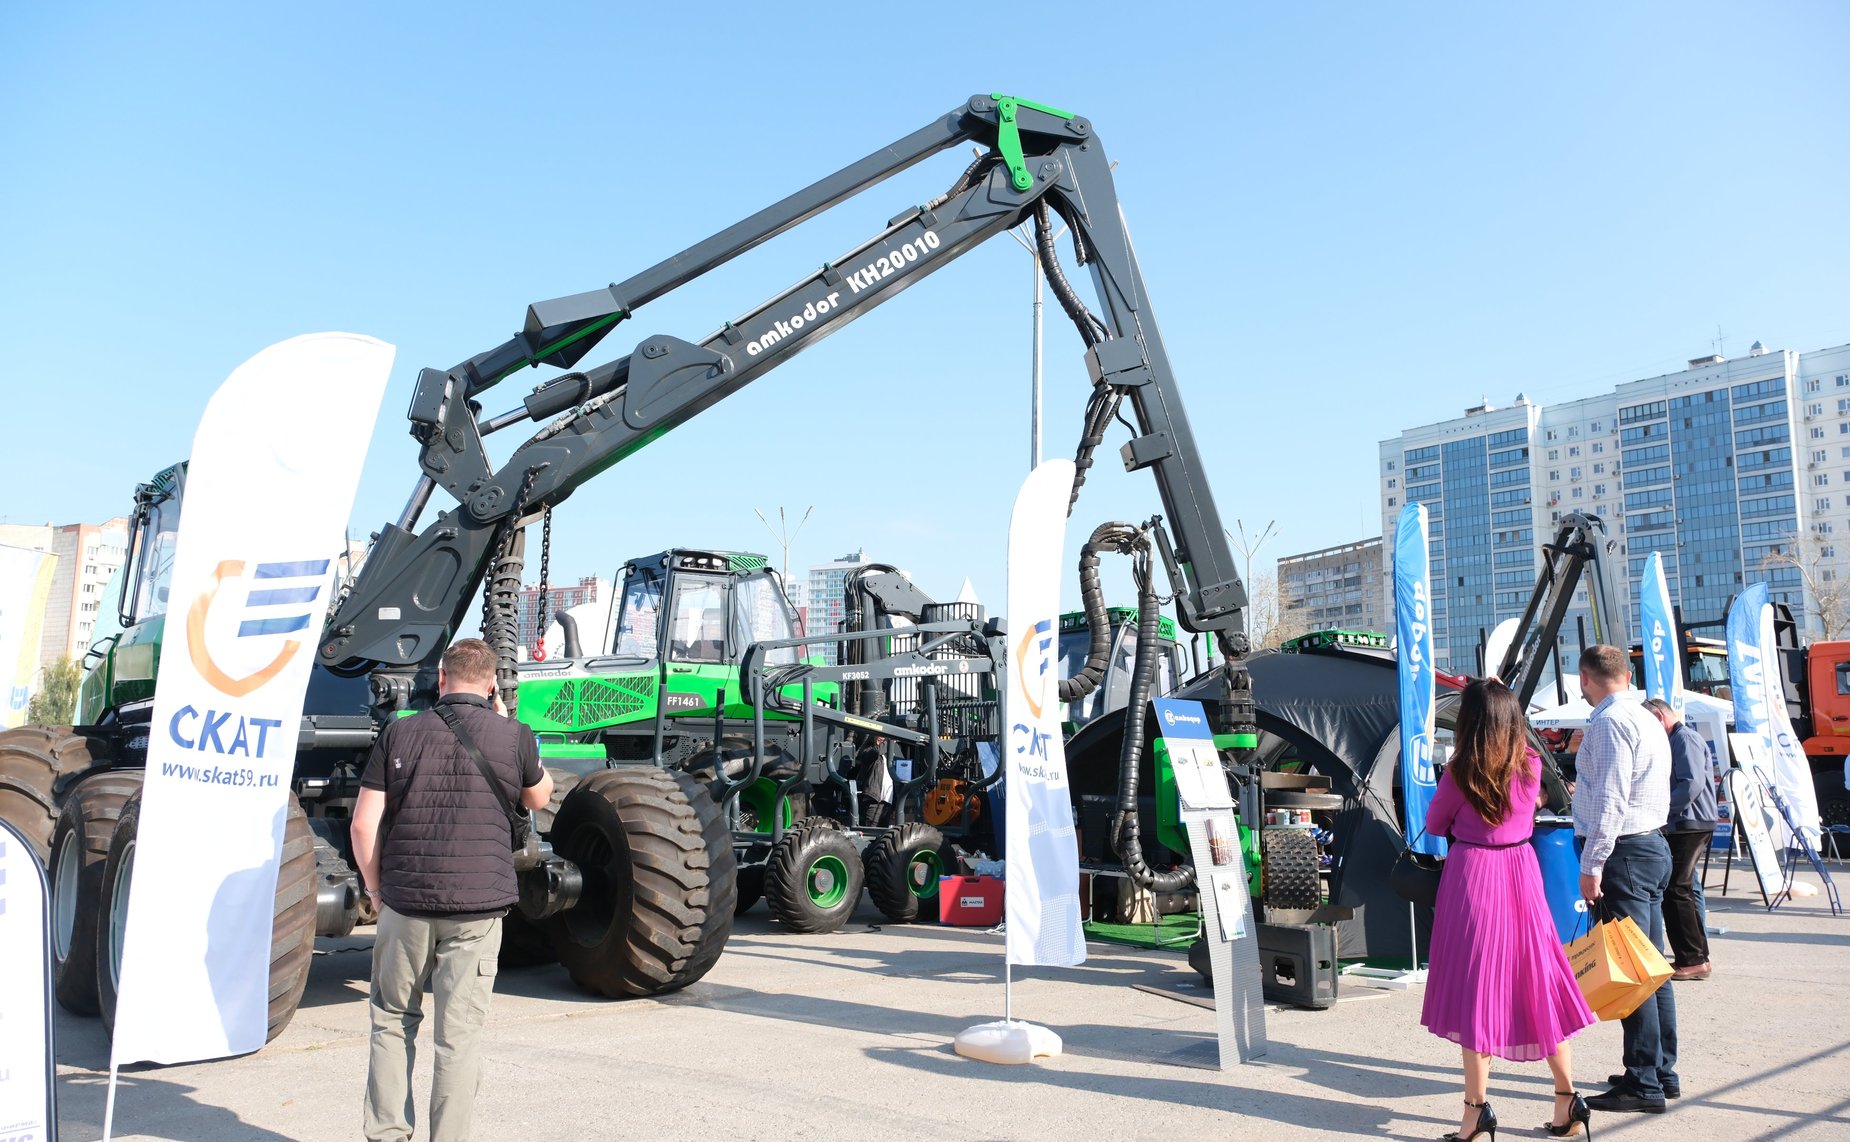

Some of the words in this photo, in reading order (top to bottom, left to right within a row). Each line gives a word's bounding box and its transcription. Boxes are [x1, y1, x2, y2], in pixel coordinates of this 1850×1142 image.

[746, 291, 840, 356] amkodor
[845, 230, 941, 294] KH20010
[523, 670, 572, 678] amkodor
[842, 671, 870, 680] KF3052
[893, 663, 949, 677] amkodor
[667, 696, 699, 707] FF1461
[168, 704, 283, 759] СКАТ
